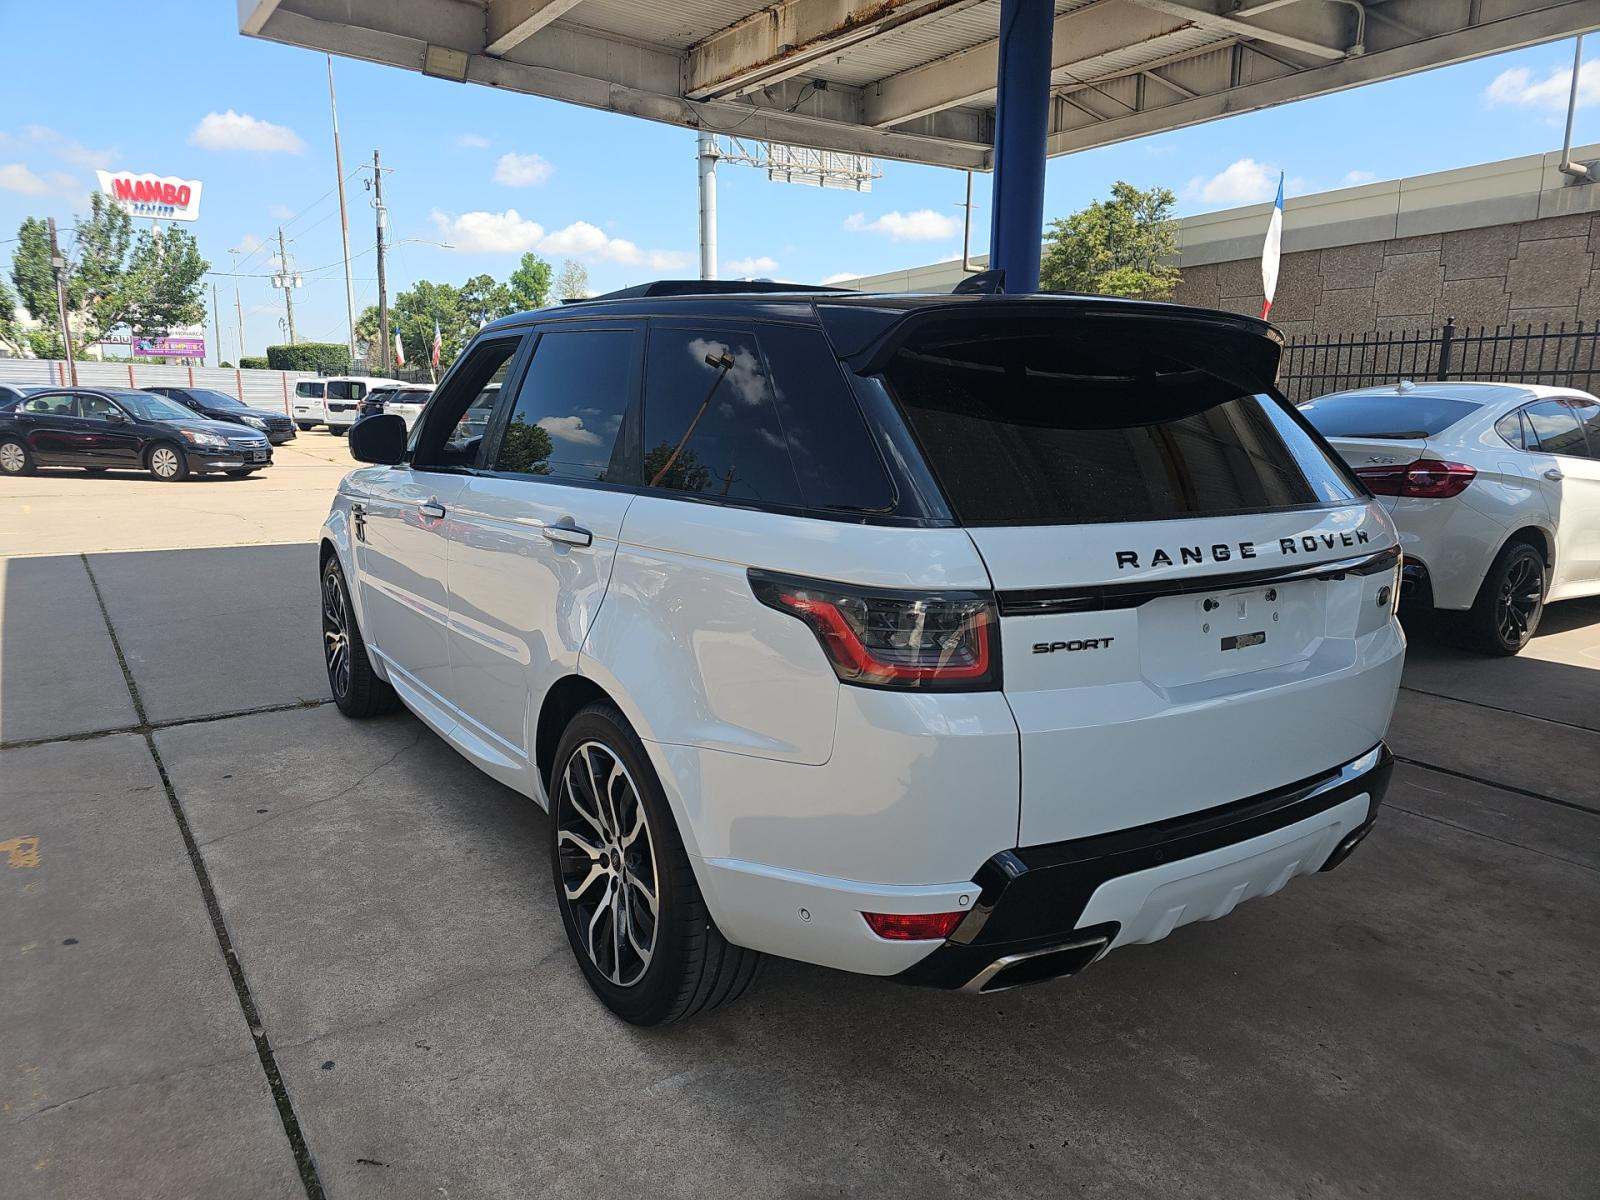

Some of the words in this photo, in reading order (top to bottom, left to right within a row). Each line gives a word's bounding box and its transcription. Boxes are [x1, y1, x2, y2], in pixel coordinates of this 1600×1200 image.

[113, 178, 192, 207] MAMBO
[1115, 541, 1257, 570] RANGE
[1279, 530, 1370, 556] ROVER
[1031, 637, 1115, 655] SPORT
